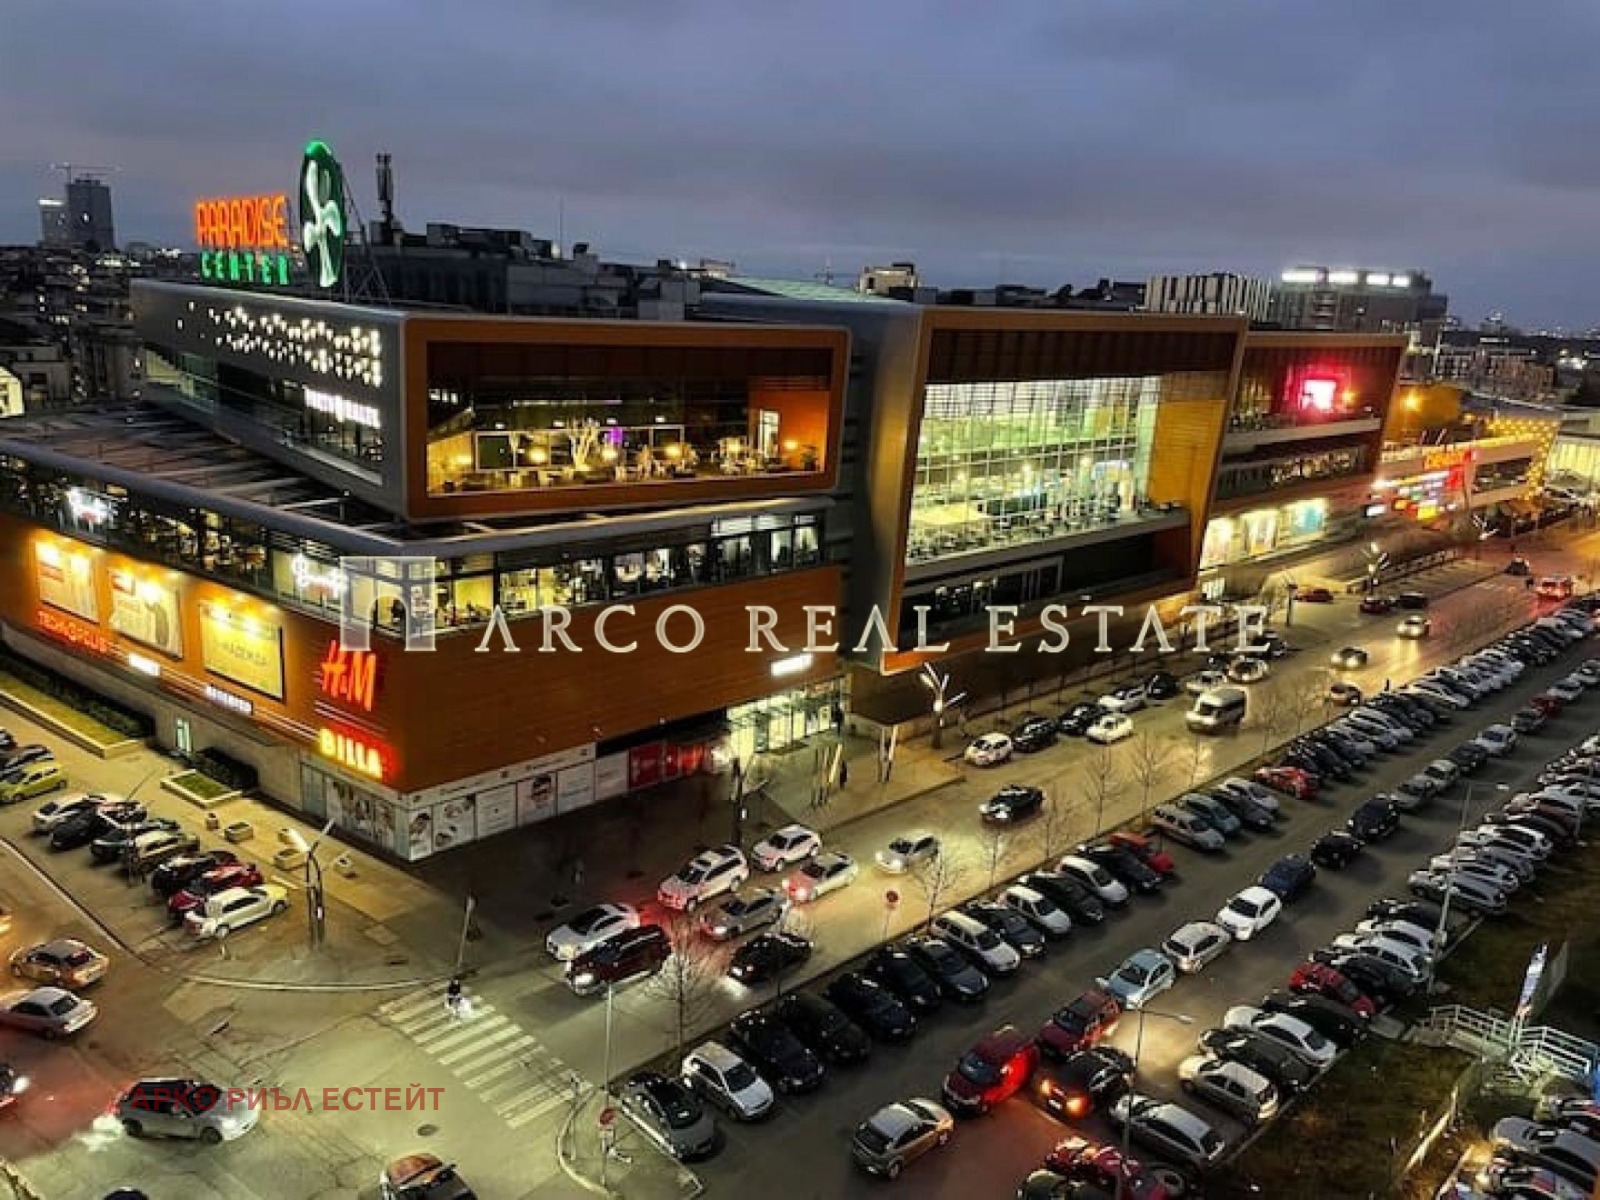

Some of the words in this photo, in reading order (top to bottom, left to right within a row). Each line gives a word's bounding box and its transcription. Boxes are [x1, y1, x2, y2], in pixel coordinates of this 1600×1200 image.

[195, 194, 289, 247] PARADISE
[201, 251, 290, 286] CENTER
[321, 639, 377, 712] H&M
[319, 728, 383, 779] BILLA
